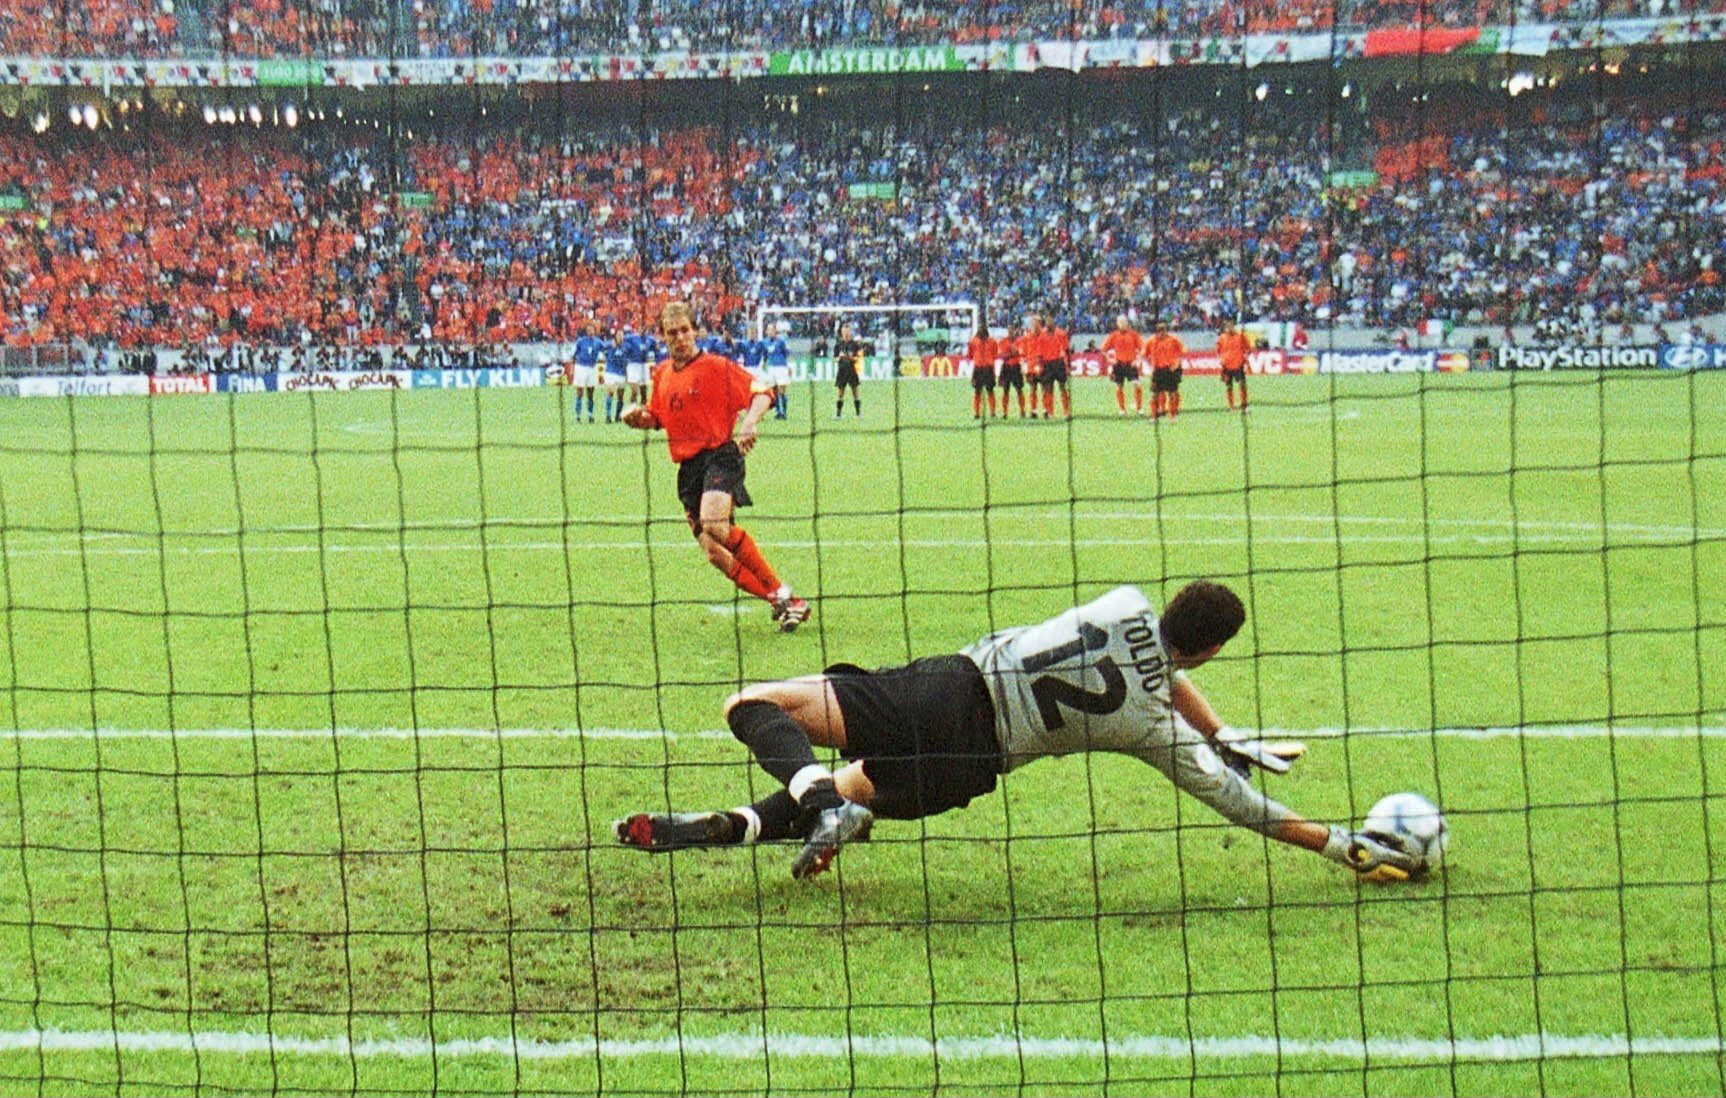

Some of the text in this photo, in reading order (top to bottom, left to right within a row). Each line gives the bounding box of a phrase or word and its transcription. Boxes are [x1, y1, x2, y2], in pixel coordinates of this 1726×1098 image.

[787, 49, 947, 73] AMSTERDAM
[1321, 352, 1434, 373] MasterCard
[1500, 345, 1657, 370] PlayStation
[58, 380, 111, 396] Telfort
[153, 377, 207, 393] TOTAL
[442, 367, 542, 387] FLY KLM
[1120, 610, 1166, 693] TOLDO
[1021, 621, 1127, 732] 12
